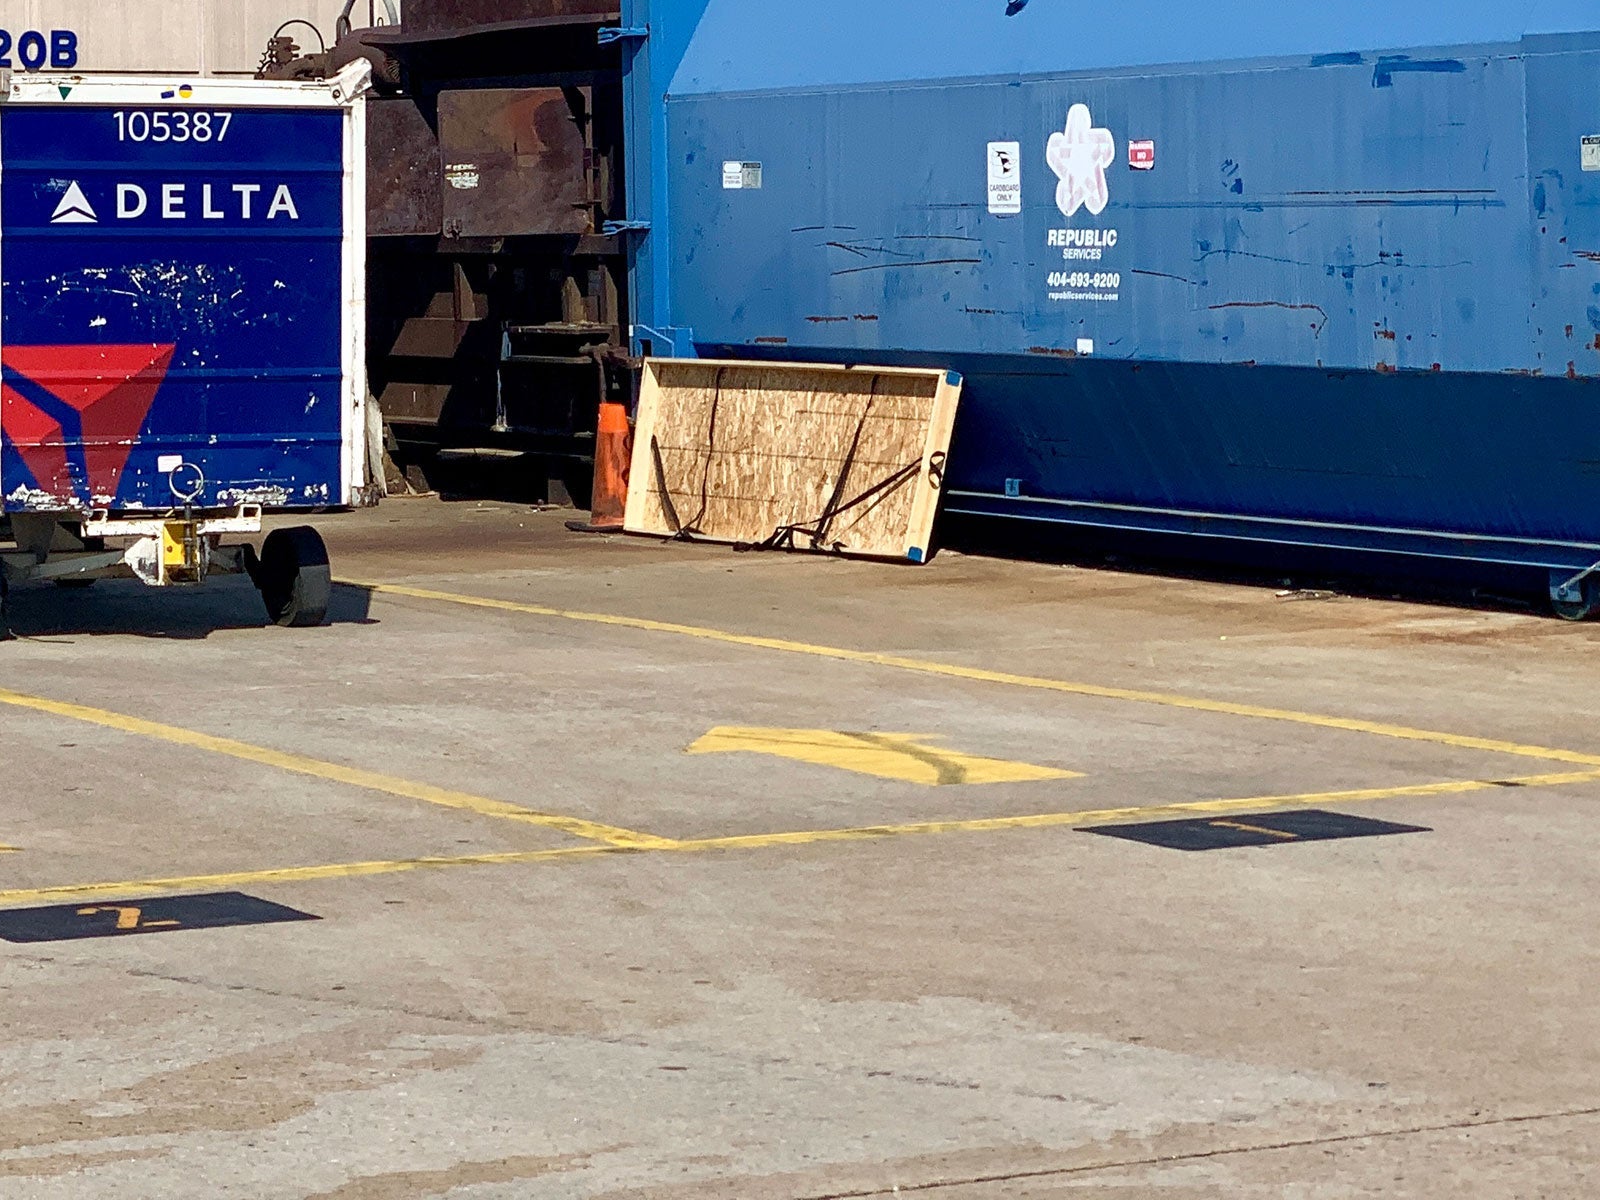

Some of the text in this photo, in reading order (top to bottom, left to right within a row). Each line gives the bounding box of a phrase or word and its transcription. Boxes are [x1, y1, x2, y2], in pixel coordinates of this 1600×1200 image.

[113, 111, 233, 142] 105387
[116, 183, 300, 220] DELTA
[996, 193, 1013, 202] ONLY
[1047, 229, 1118, 247] REPUBLIC
[1062, 248, 1102, 260] SERVICES
[1047, 271, 1120, 288] 404-693-9200
[1048, 291, 1119, 301] republicservices.com
